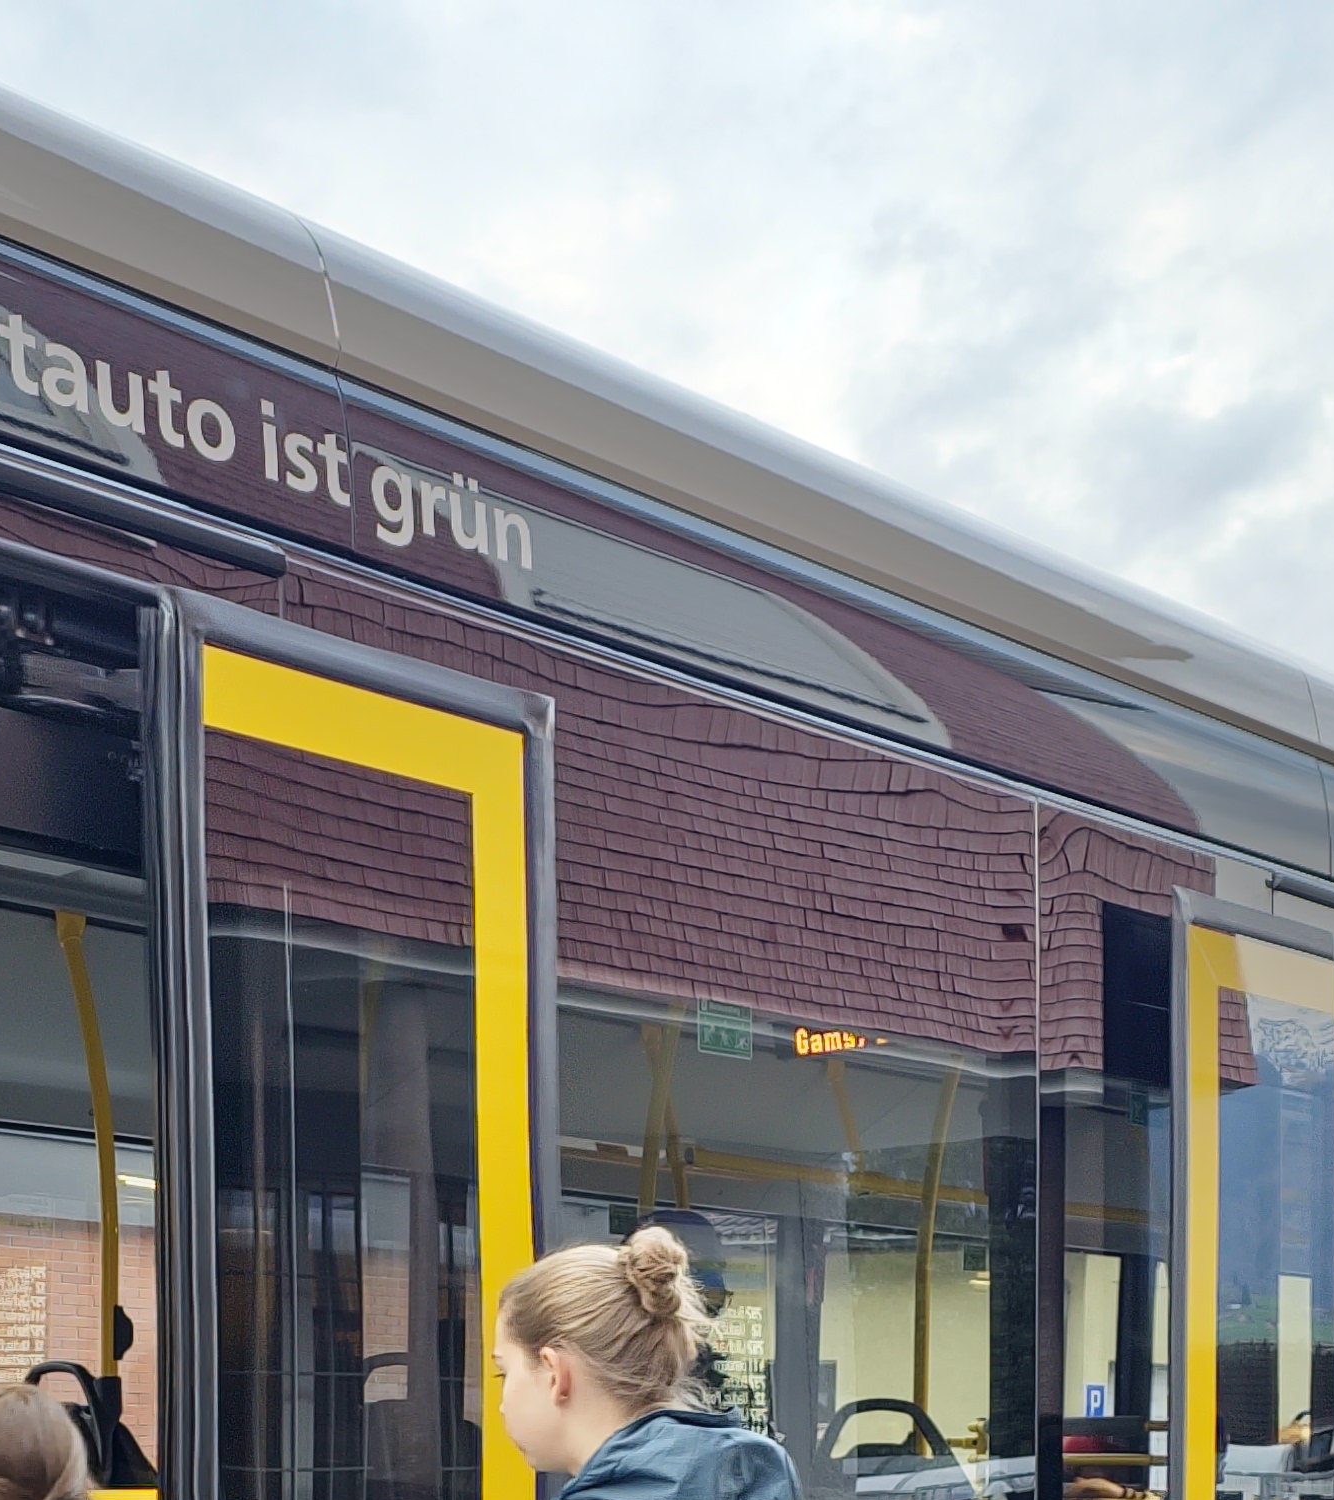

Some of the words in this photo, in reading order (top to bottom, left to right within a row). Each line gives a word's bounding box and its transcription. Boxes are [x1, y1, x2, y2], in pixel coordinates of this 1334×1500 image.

[263, 400, 353, 509] ist
[369, 462, 534, 570] grün
[1090, 1389, 1102, 1417] P
